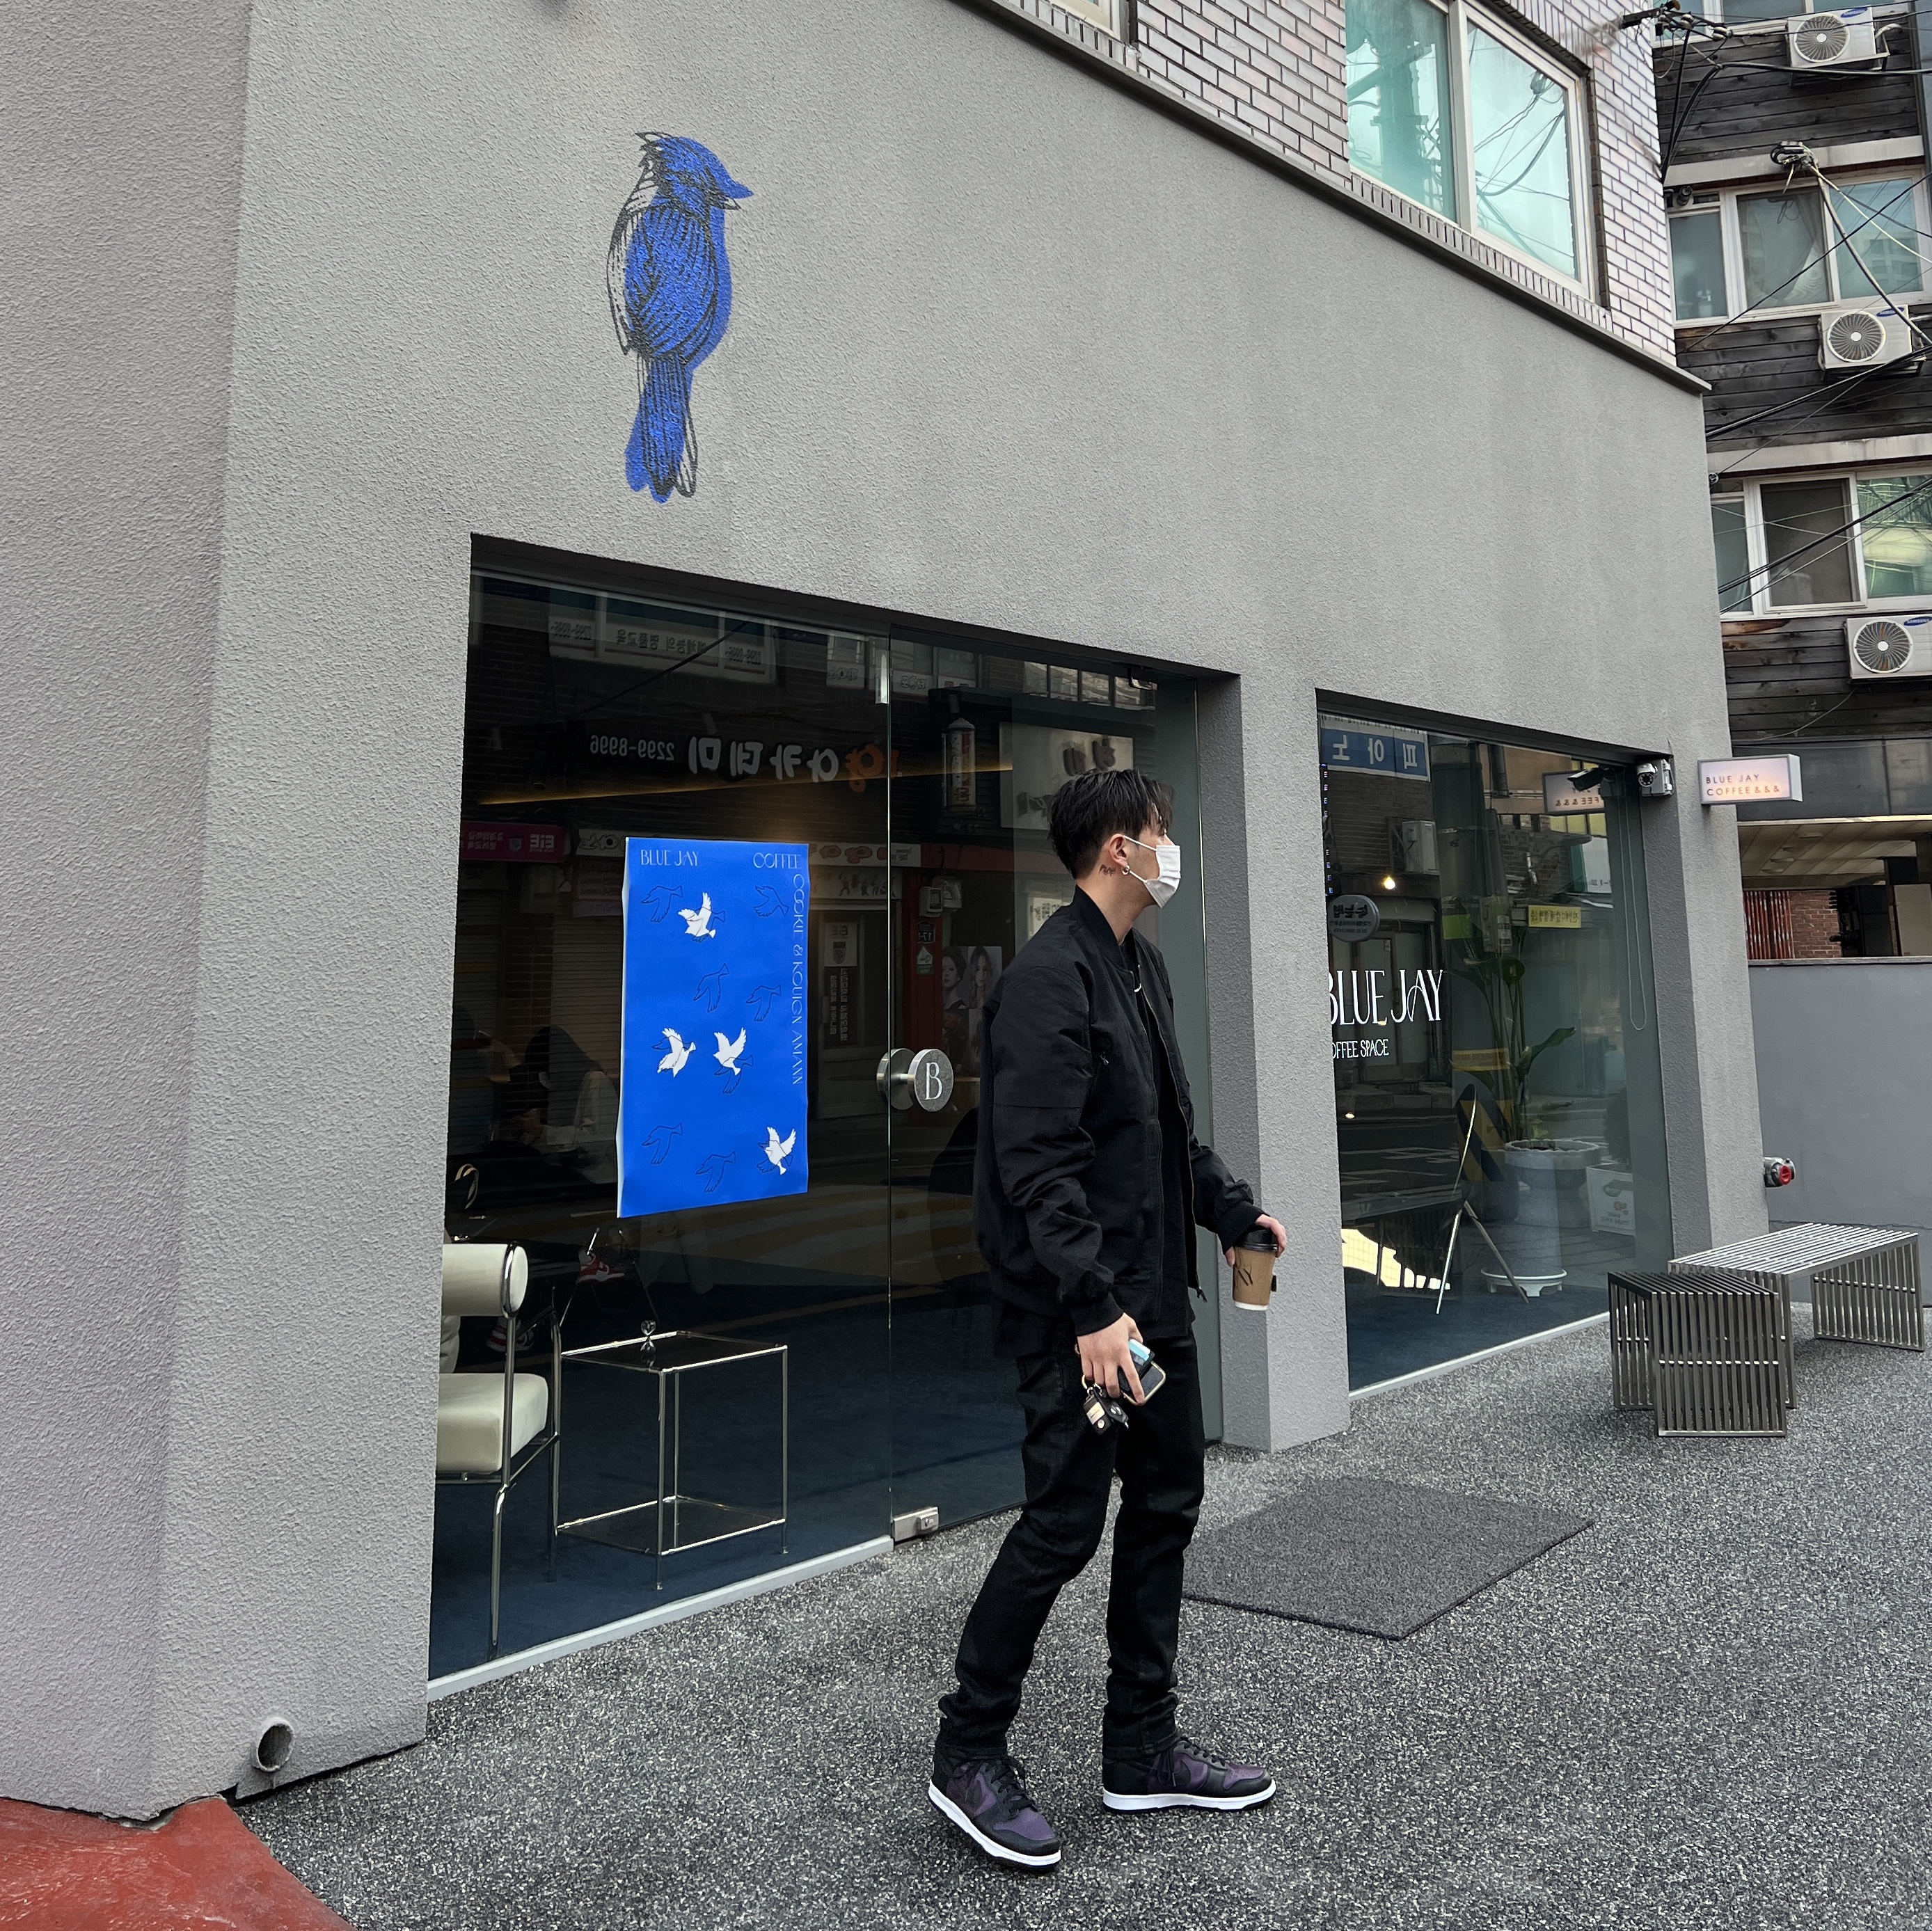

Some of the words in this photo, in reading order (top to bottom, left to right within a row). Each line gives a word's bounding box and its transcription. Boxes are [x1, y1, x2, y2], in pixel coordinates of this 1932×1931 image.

[1706, 775, 1732, 784] BLUE
[1739, 774, 1759, 782] JAY
[640, 849, 671, 866] BLUE
[674, 850, 699, 867] JAY
[753, 852, 801, 869] COFFEE
[793, 873, 805, 940] COOKIE
[793, 944, 803, 956] &
[1391, 969, 1443, 1023] JAY
[1332, 1040, 1359, 1059] OFFEE
[1360, 1038, 1390, 1058] SPACE
[925, 1062, 942, 1100] B
